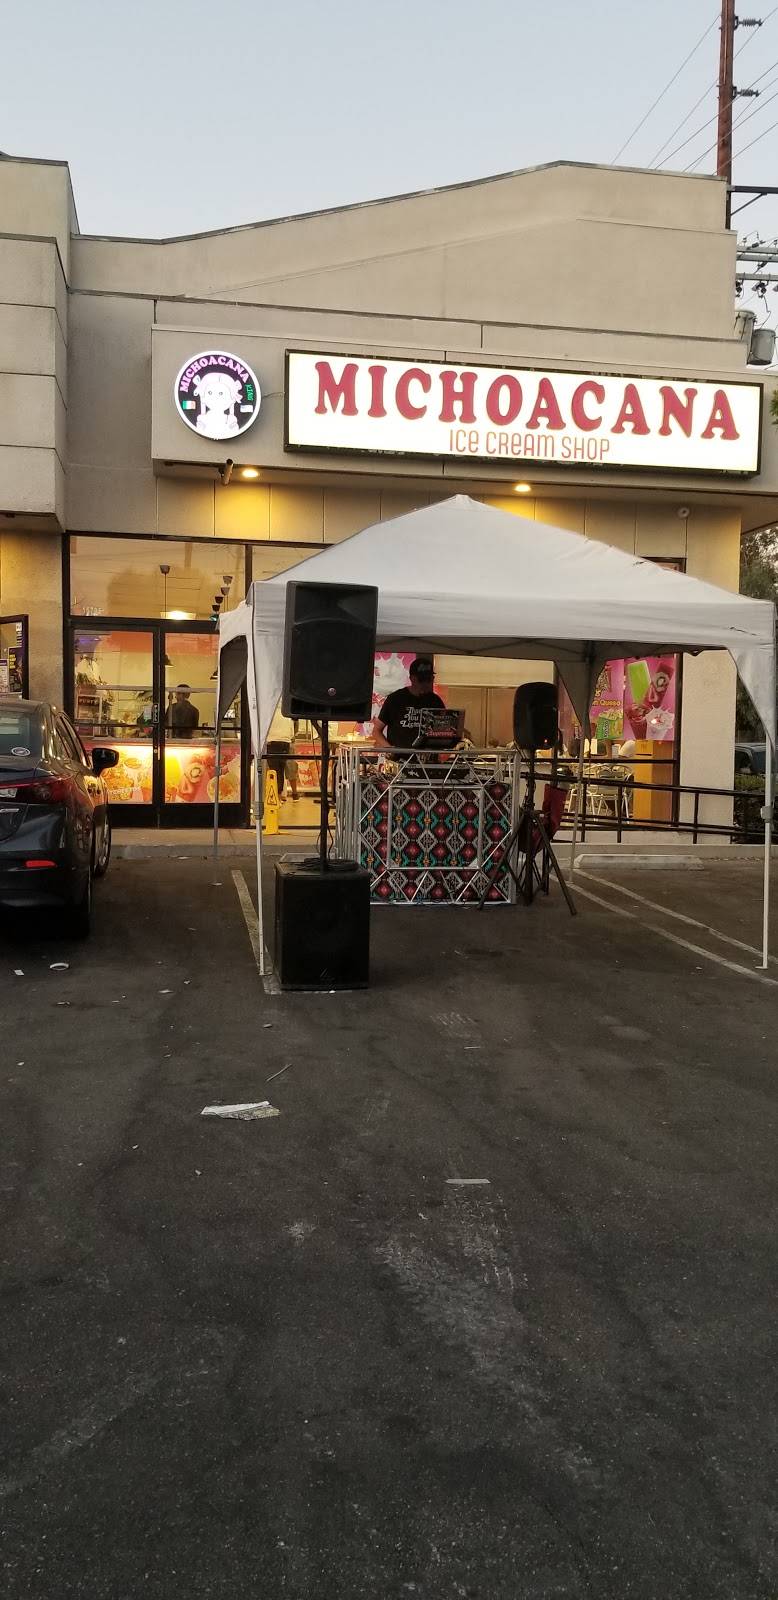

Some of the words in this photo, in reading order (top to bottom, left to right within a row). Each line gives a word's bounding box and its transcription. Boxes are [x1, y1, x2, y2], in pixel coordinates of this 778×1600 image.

[180, 356, 250, 392] MICHOACANA
[314, 360, 740, 441] MICHOACANA
[561, 436, 610, 461] SHOP
